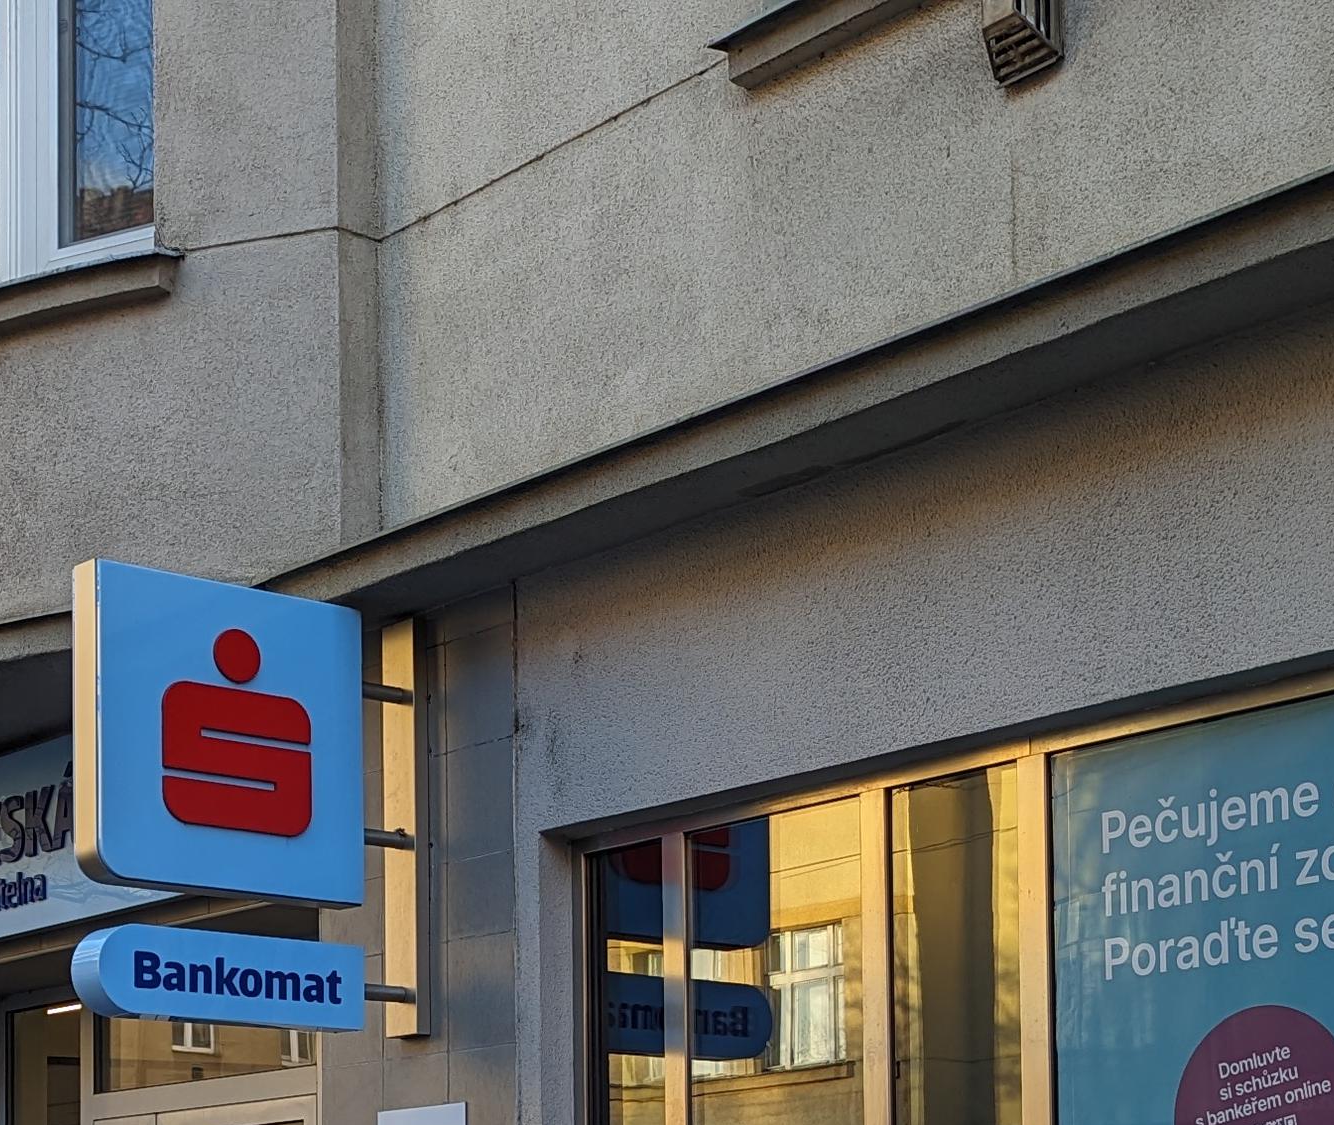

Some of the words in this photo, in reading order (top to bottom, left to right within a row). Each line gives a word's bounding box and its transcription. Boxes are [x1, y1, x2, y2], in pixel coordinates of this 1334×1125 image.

[1101, 782, 1319, 854] Pečujeme
[1101, 844, 1279, 918] finanční
[1103, 917, 1279, 981] Poraďte
[133, 950, 342, 1005] Bankomat
[1218, 1045, 1291, 1079] Domluvte
[1219, 1084, 1233, 1101] si
[1235, 1065, 1299, 1097] schůzku
[1285, 1078, 1332, 1105] online
